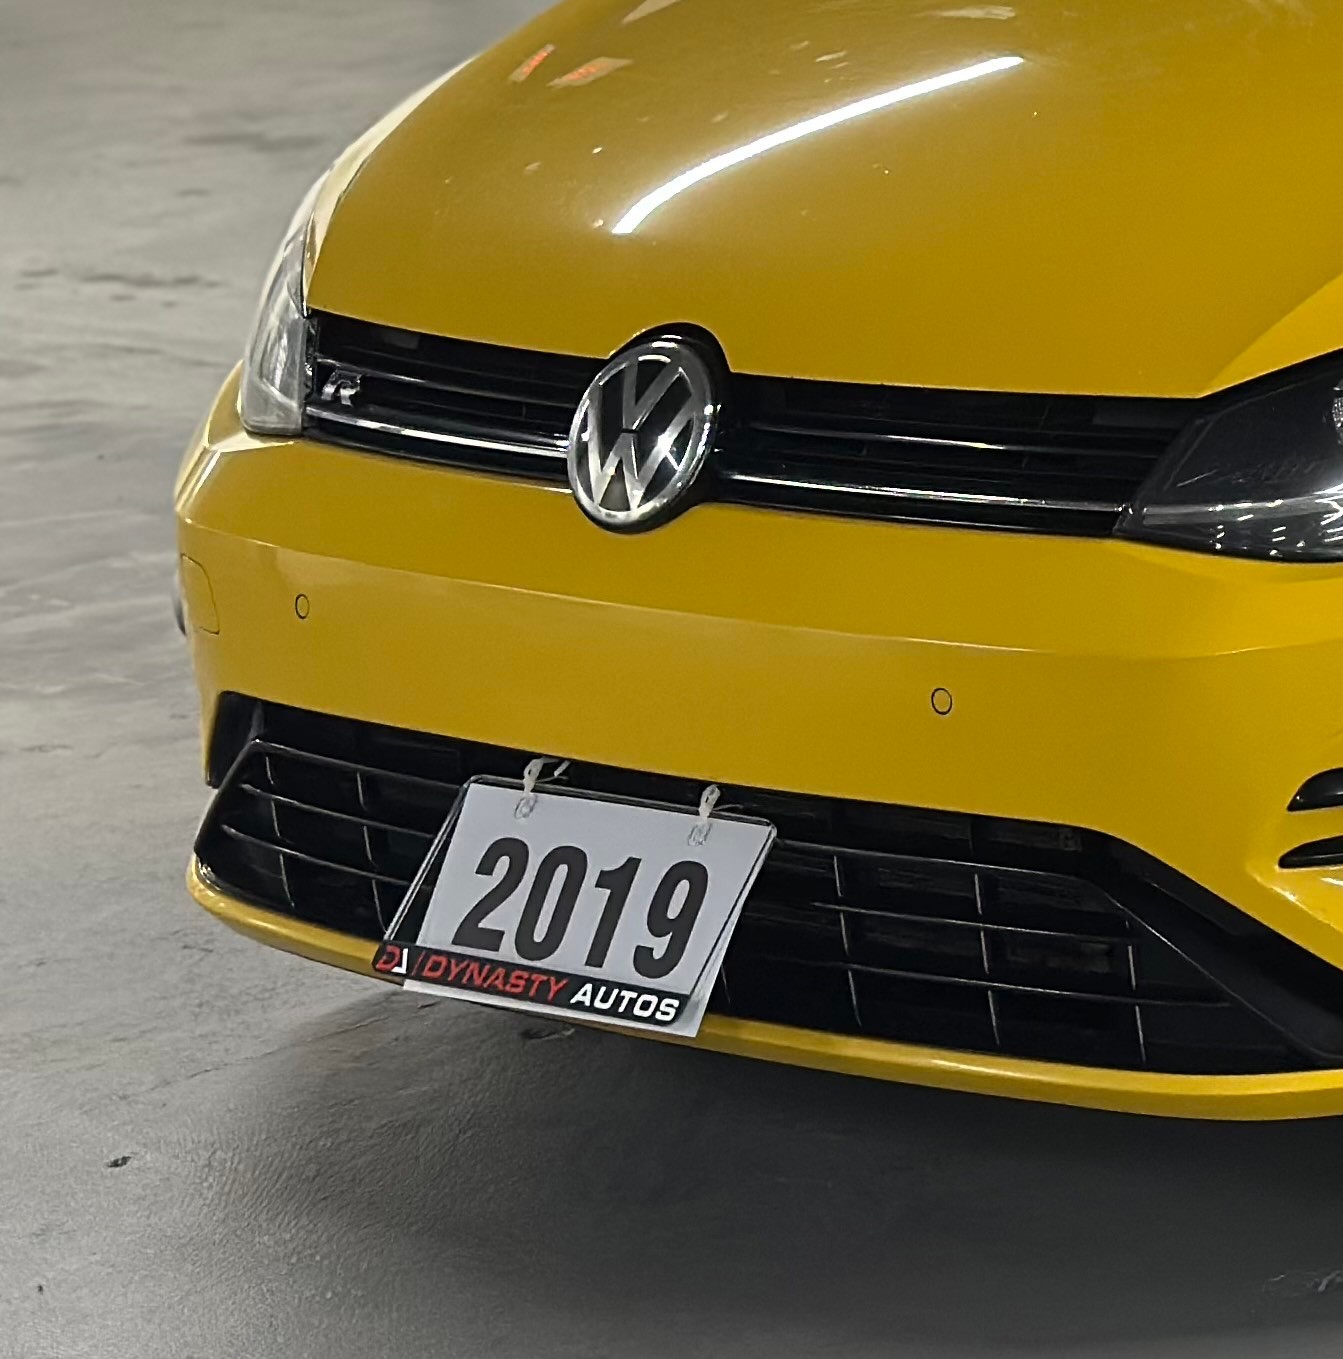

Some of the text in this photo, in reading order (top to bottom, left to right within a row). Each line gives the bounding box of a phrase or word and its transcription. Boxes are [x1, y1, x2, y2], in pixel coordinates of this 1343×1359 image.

[451, 837, 709, 979] 2019
[423, 954, 568, 1003] DYNASTY
[569, 982, 680, 1022] AUTOS
